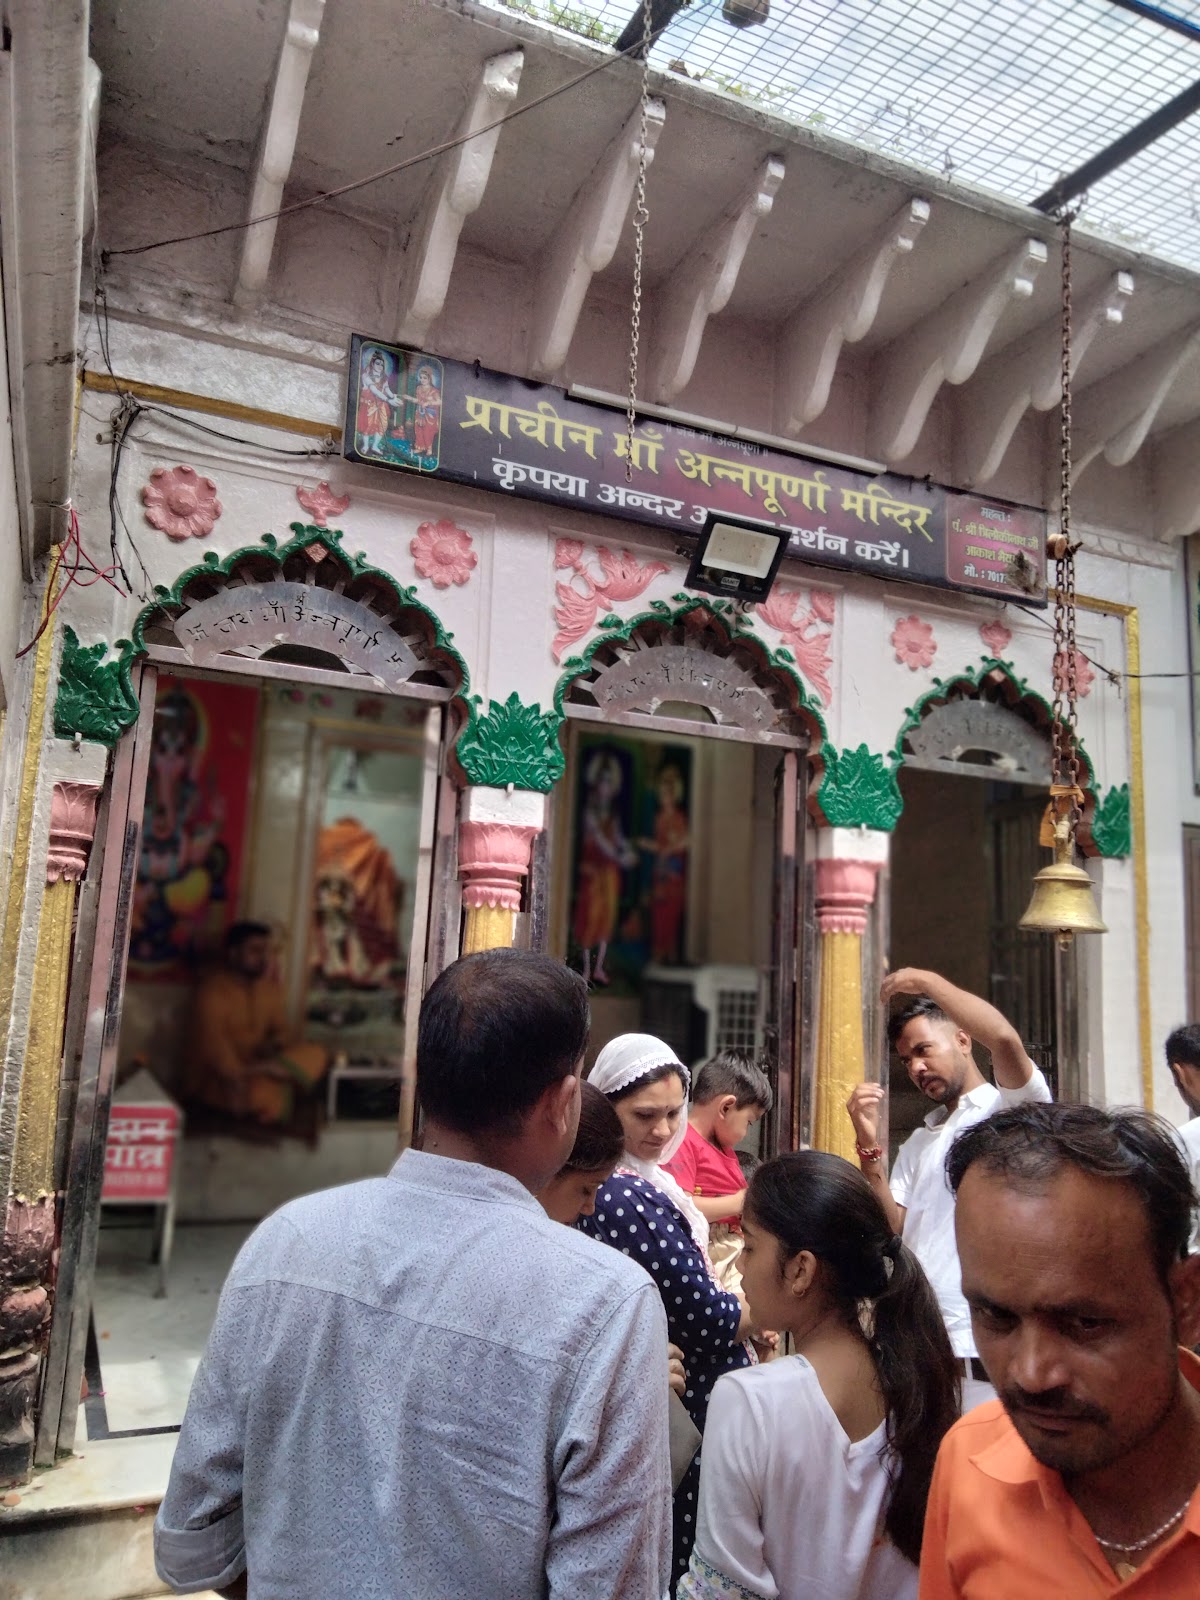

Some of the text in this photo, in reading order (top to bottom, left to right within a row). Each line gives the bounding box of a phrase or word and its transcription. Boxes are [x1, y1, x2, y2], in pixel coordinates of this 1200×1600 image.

[459, 395, 934, 543] प्राचीन माँ अन्नपूर्णा मन्दिर
[491, 457, 590, 498] कृपया
[596, 482, 685, 520] अन्दर
